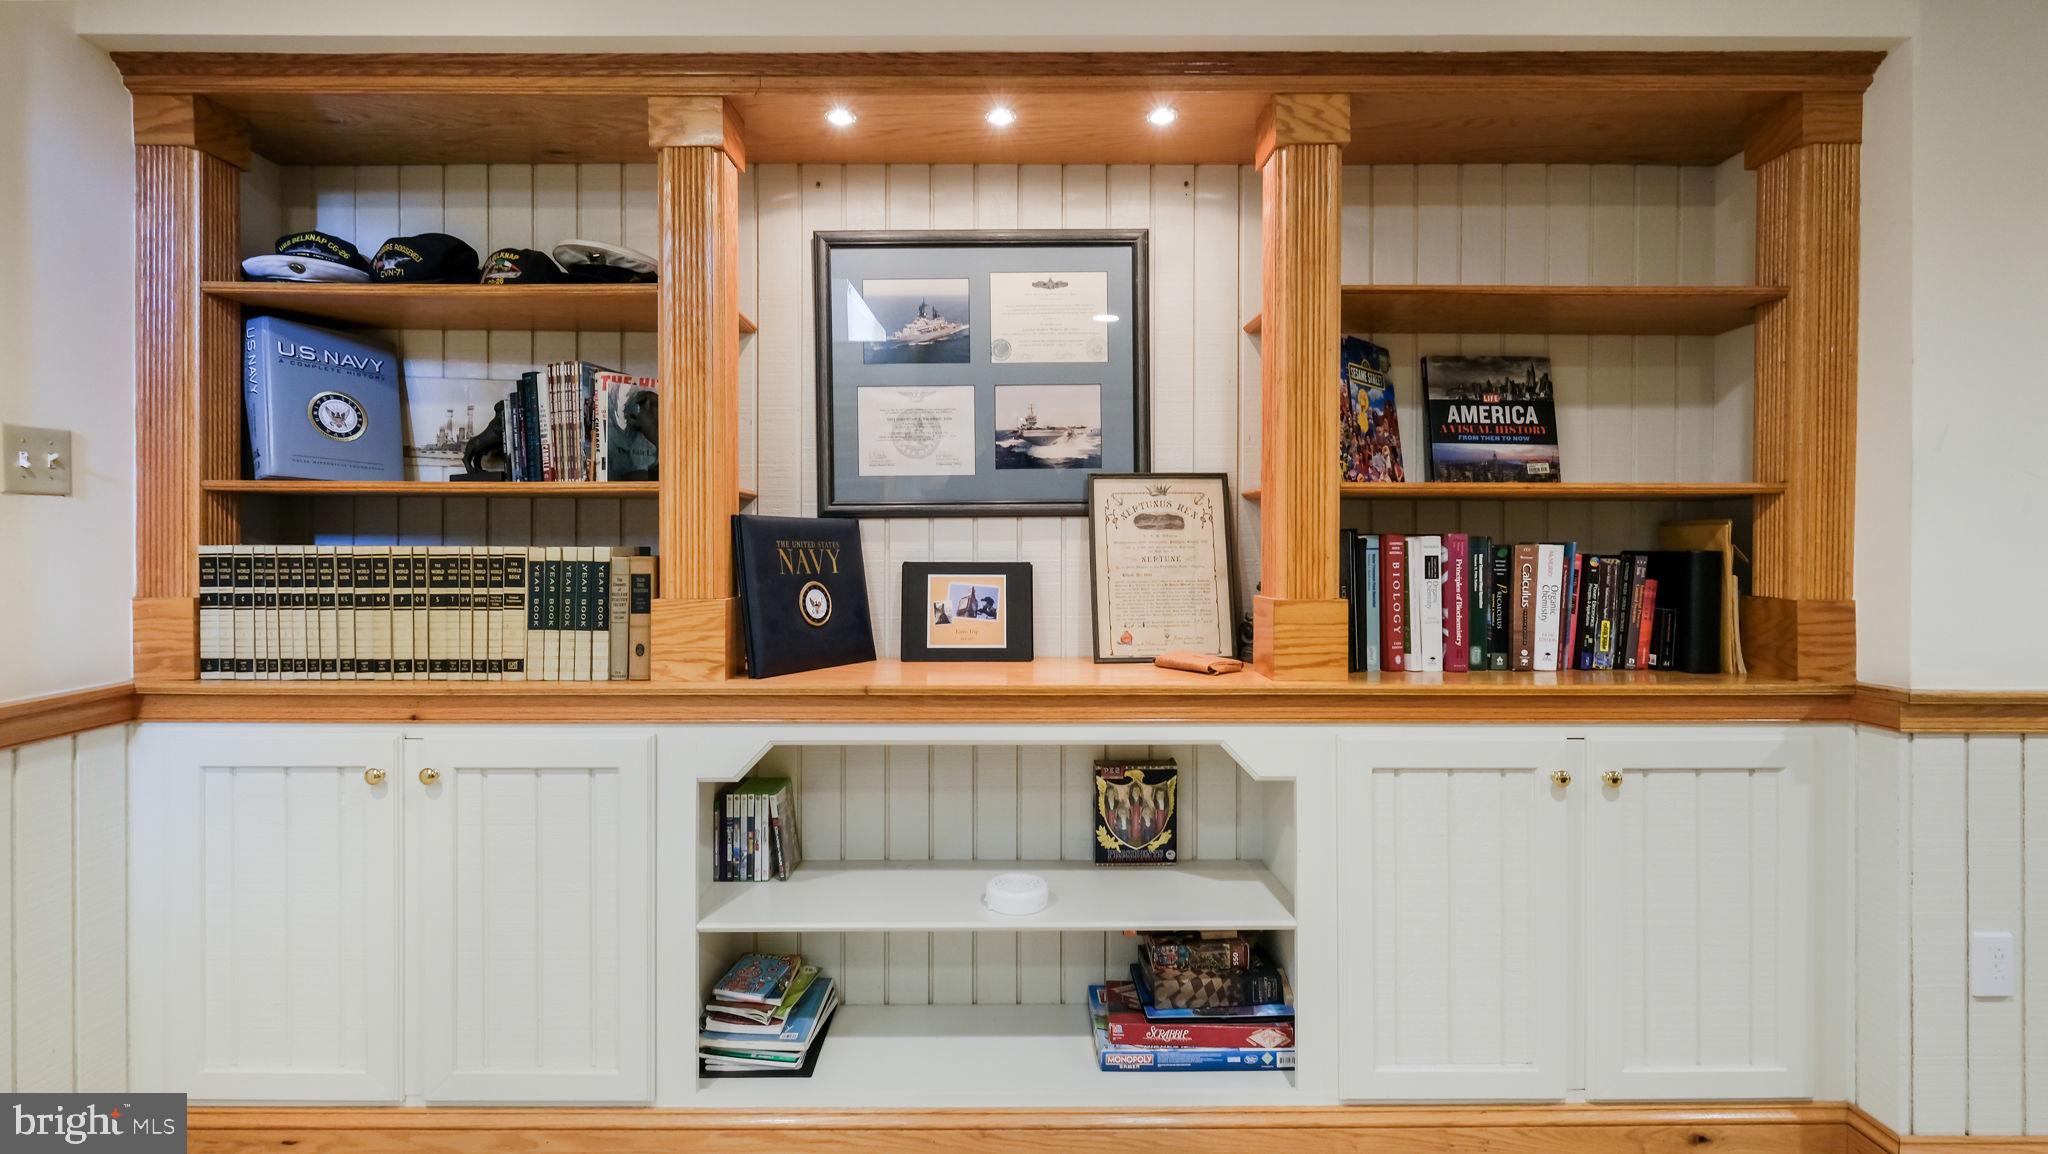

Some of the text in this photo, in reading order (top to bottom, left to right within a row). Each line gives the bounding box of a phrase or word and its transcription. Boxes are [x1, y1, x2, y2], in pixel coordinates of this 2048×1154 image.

[291, 233, 328, 245] BELKNAP
[327, 241, 351, 260] CG-26
[394, 243, 423, 263] ROOSEVELT
[380, 268, 404, 279] CVN-71
[277, 341, 384, 373] U.S. NAVY
[248, 354, 259, 395] NAVY
[289, 360, 342, 374] COMPLETE
[346, 371, 386, 381] HISTORY
[1350, 366, 1384, 387] SESAME STREET
[1483, 394, 1500, 403] LIFE
[1447, 405, 1539, 424] AMERICA
[1448, 424, 1492, 434] VISUAL
[1495, 425, 1547, 435] HISTORY
[1120, 499, 1199, 521] NEPTUNUS REX
[776, 540, 841, 549] THE UNITED STATES
[777, 549, 841, 575] NAVY
[1141, 555, 1182, 563] NEPTUNE
[1455, 558, 1463, 592] Principles
[1521, 563, 1532, 608] Calculus
[1392, 561, 1401, 633] BIOLOGY
[1456, 593, 1463, 601] of
[1496, 583, 1507, 629] PRECALCULUS
[1539, 584, 1550, 622] Chemistry
[1549, 585, 1559, 615] Organic
[1455, 601, 1463, 647] Biochemistry
[1146, 1026, 1190, 1043] SCRABBLE
[1106, 1054, 1153, 1064] MONOPOLY
